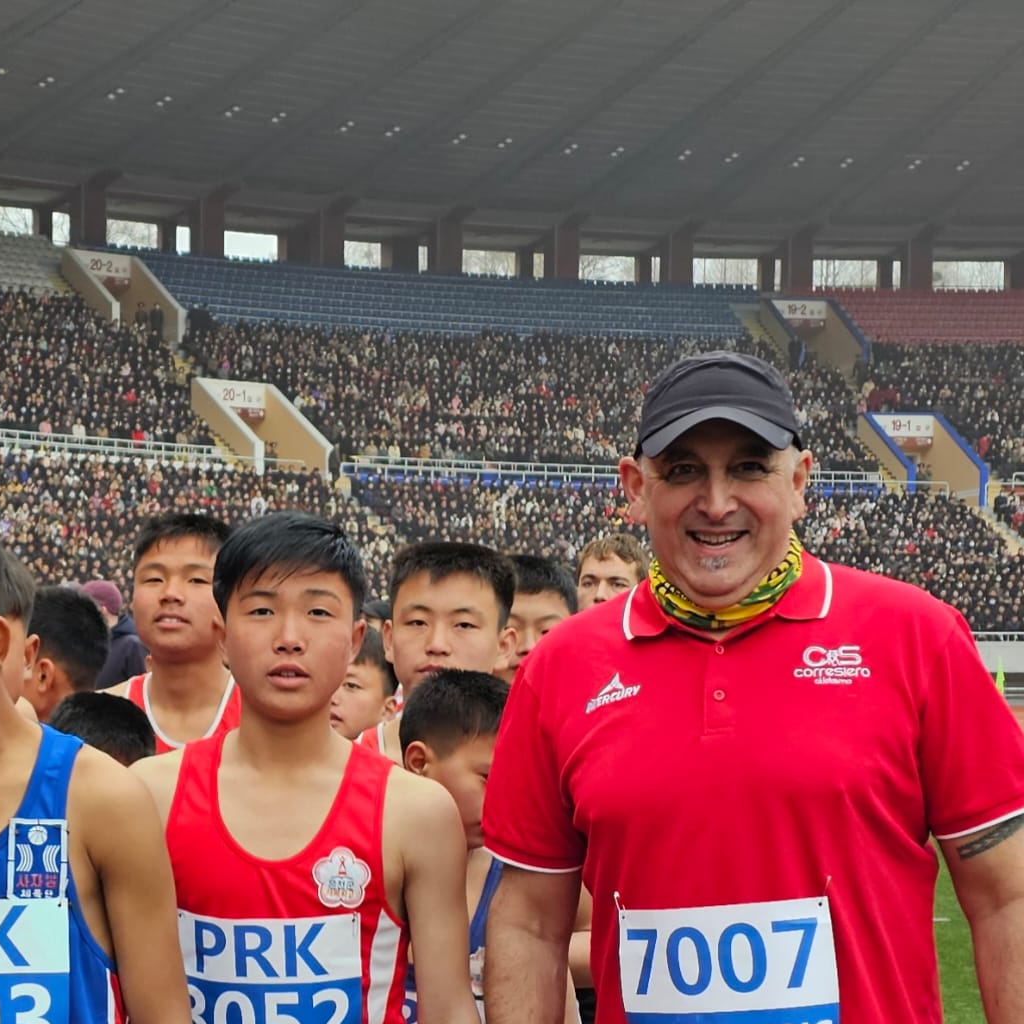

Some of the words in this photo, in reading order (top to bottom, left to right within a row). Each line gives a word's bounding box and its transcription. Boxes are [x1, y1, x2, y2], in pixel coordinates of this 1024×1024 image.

[90, 258, 113, 273] 20-2
[787, 303, 807, 316] 19-2
[222, 387, 247, 402] 20-1
[892, 419, 912, 432] 19-1
[194, 919, 329, 978] PRK
[627, 917, 818, 996] 7007
